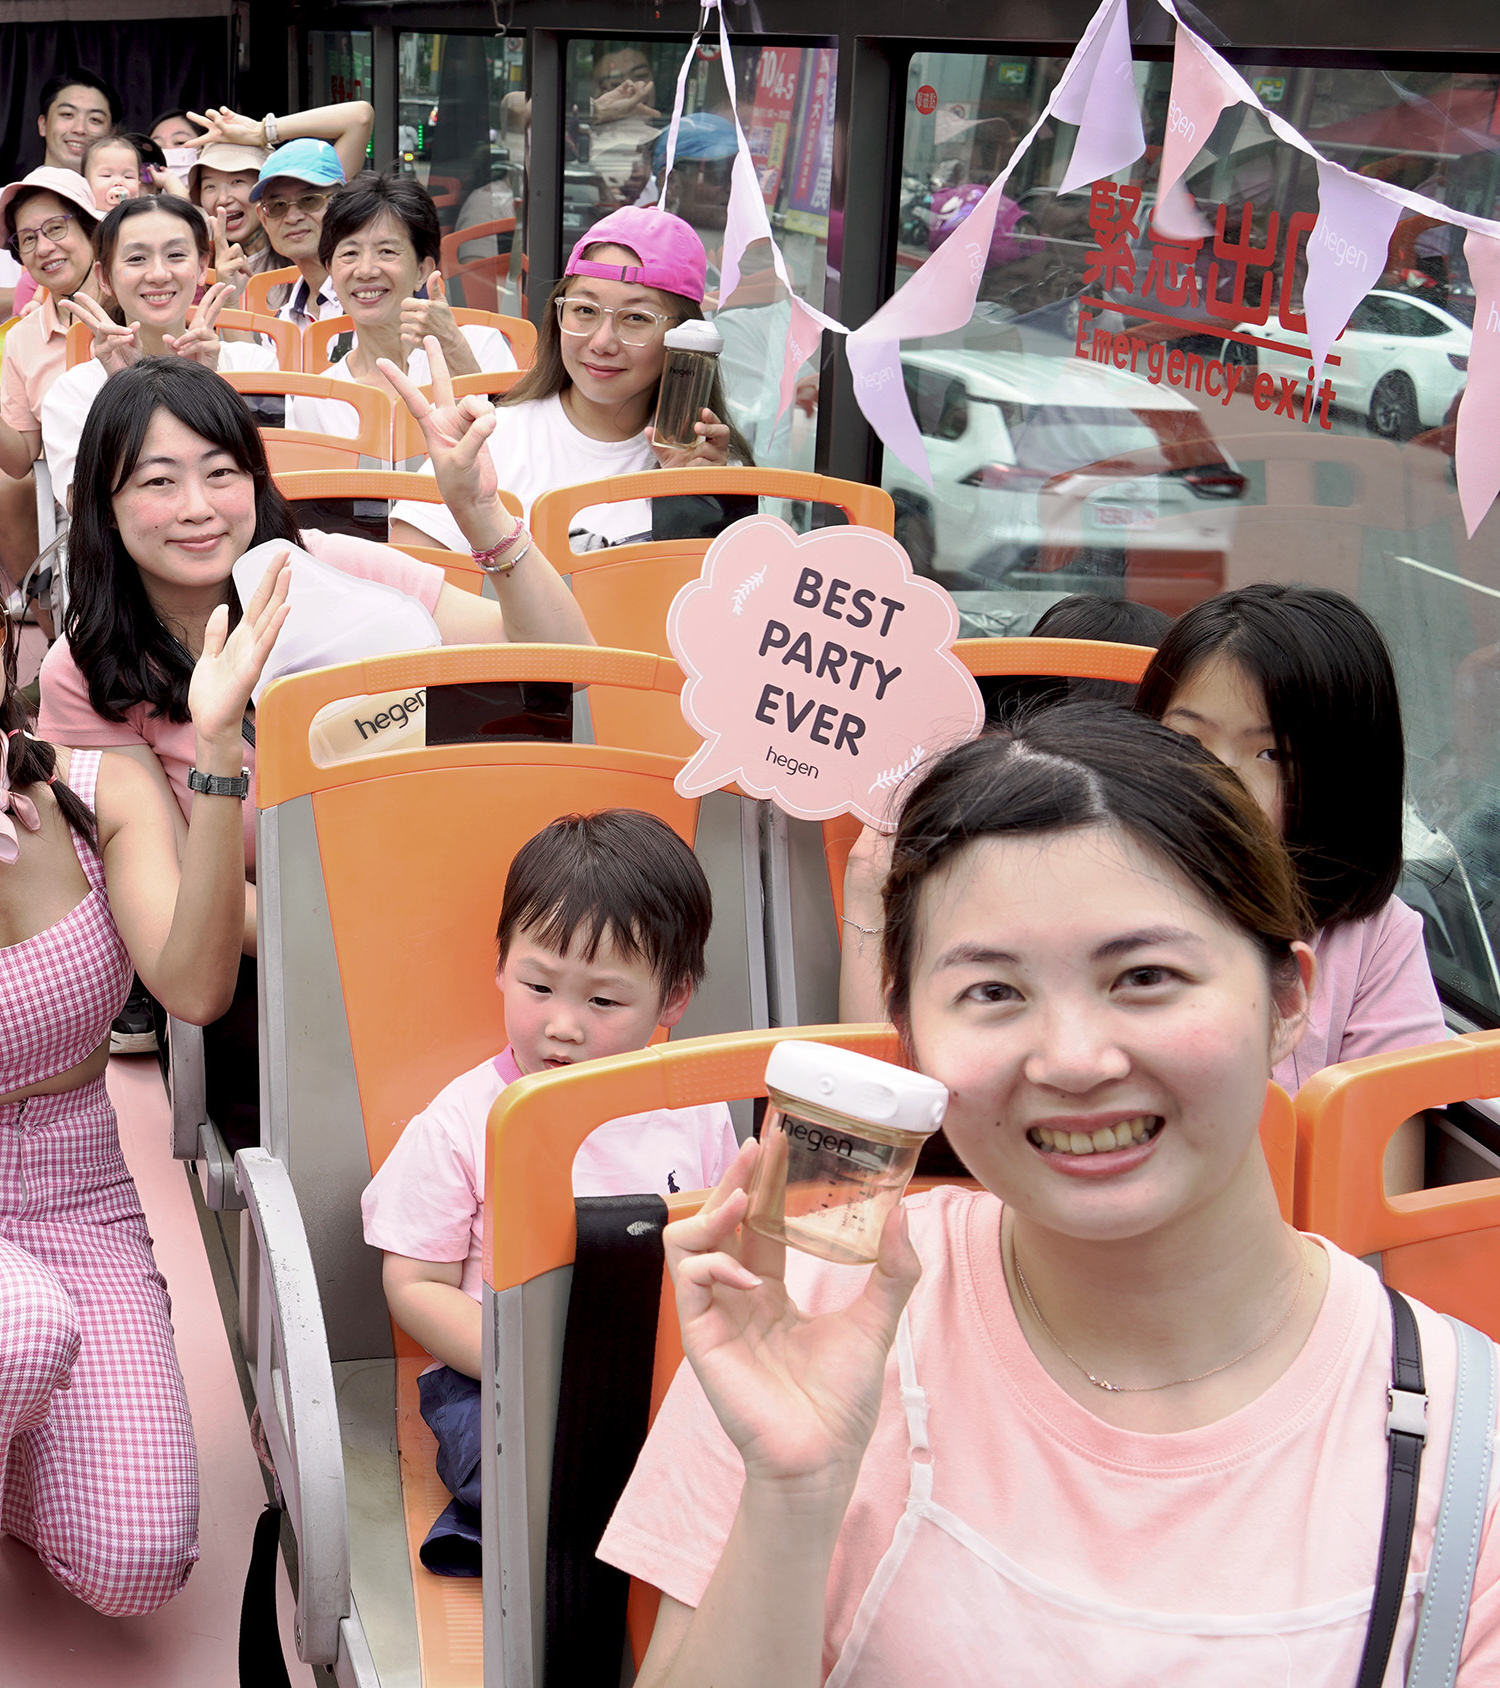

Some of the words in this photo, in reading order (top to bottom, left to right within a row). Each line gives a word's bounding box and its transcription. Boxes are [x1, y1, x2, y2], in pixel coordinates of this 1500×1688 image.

[1169, 99, 1196, 143] egen
[1318, 215, 1368, 272] hegen
[669, 366, 695, 378] hegen
[860, 366, 895, 391] hegen
[1075, 310, 1244, 406] Emergency
[1253, 365, 1337, 430] exit
[792, 566, 905, 637] BEST
[758, 619, 902, 700] PARTY
[755, 683, 866, 757] EVER
[765, 745, 820, 779] hegen
[780, 1113, 853, 1157] hegen
